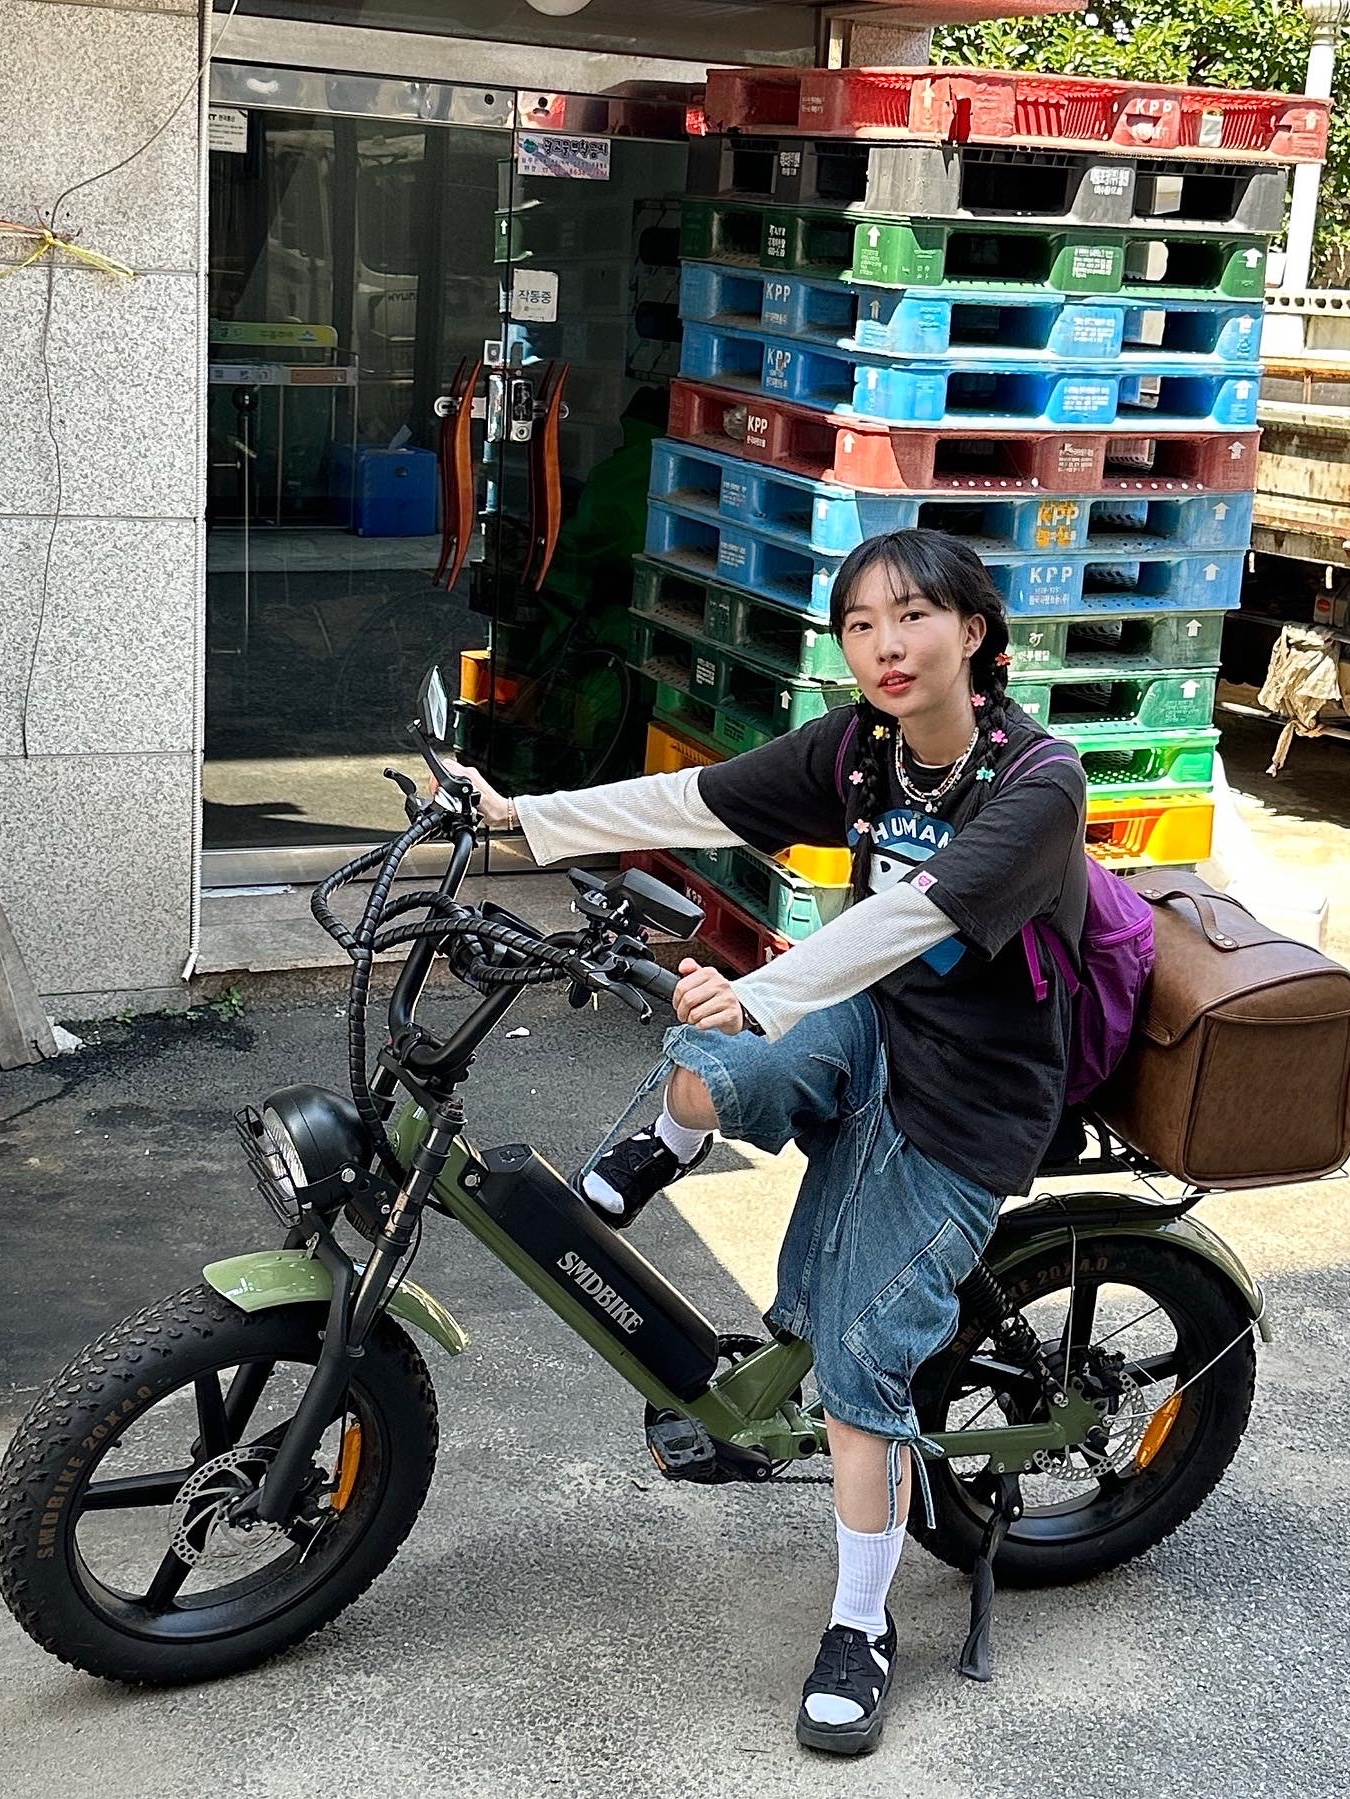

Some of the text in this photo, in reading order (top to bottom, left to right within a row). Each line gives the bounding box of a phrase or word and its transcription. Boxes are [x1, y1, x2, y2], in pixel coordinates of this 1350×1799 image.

[1135, 98, 1173, 116] KPP
[518, 289, 552, 305] 작동중
[765, 283, 791, 303] KPP
[767, 347, 792, 371] KPP
[747, 415, 768, 434] KPP
[1036, 504, 1080, 527] KPP
[1030, 565, 1074, 584] KPP
[556, 1251, 644, 1334] SMDBIKE
[36, 1456, 85, 1560] SMDBIKE
